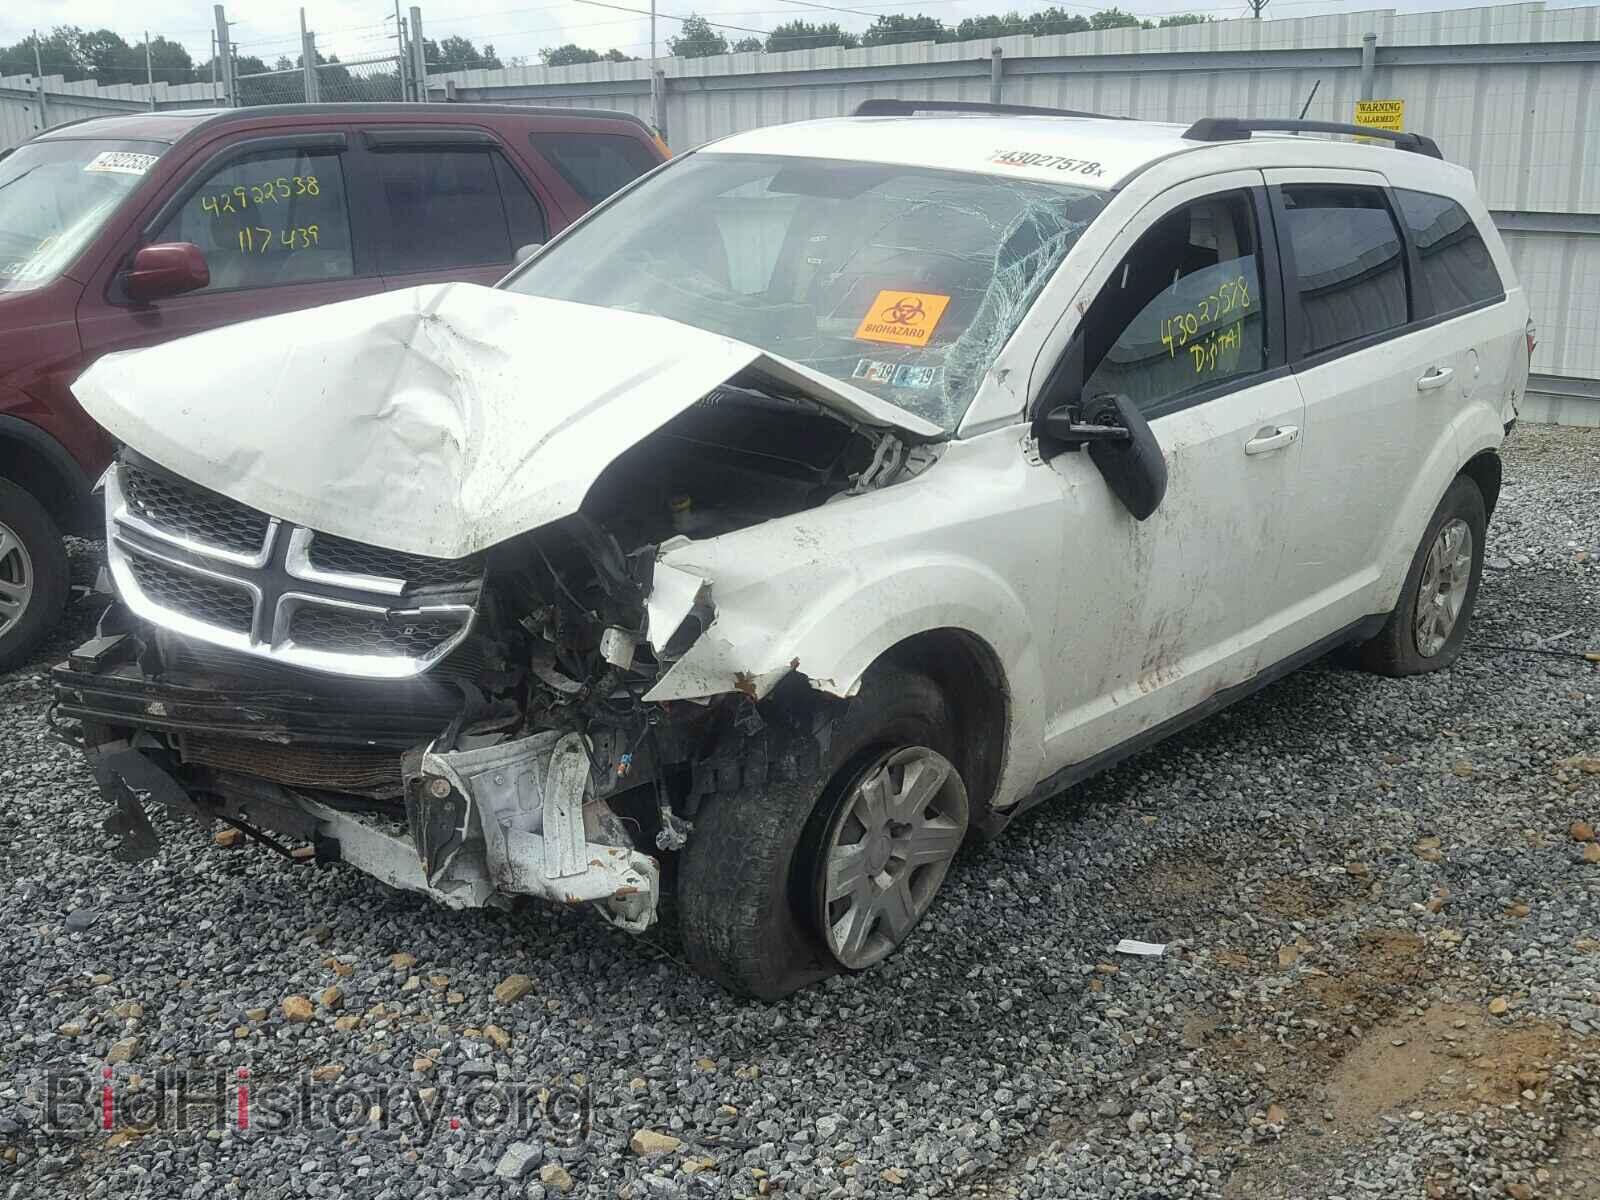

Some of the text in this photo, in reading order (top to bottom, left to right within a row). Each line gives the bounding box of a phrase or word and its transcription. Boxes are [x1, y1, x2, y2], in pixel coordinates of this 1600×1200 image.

[1359, 102, 1401, 112] WARNING
[201, 176, 320, 217] 42922538
[239, 225, 320, 254] 117 439
[864, 323, 925, 338] BIOHAZARD
[1160, 276, 1250, 359] 43027578
